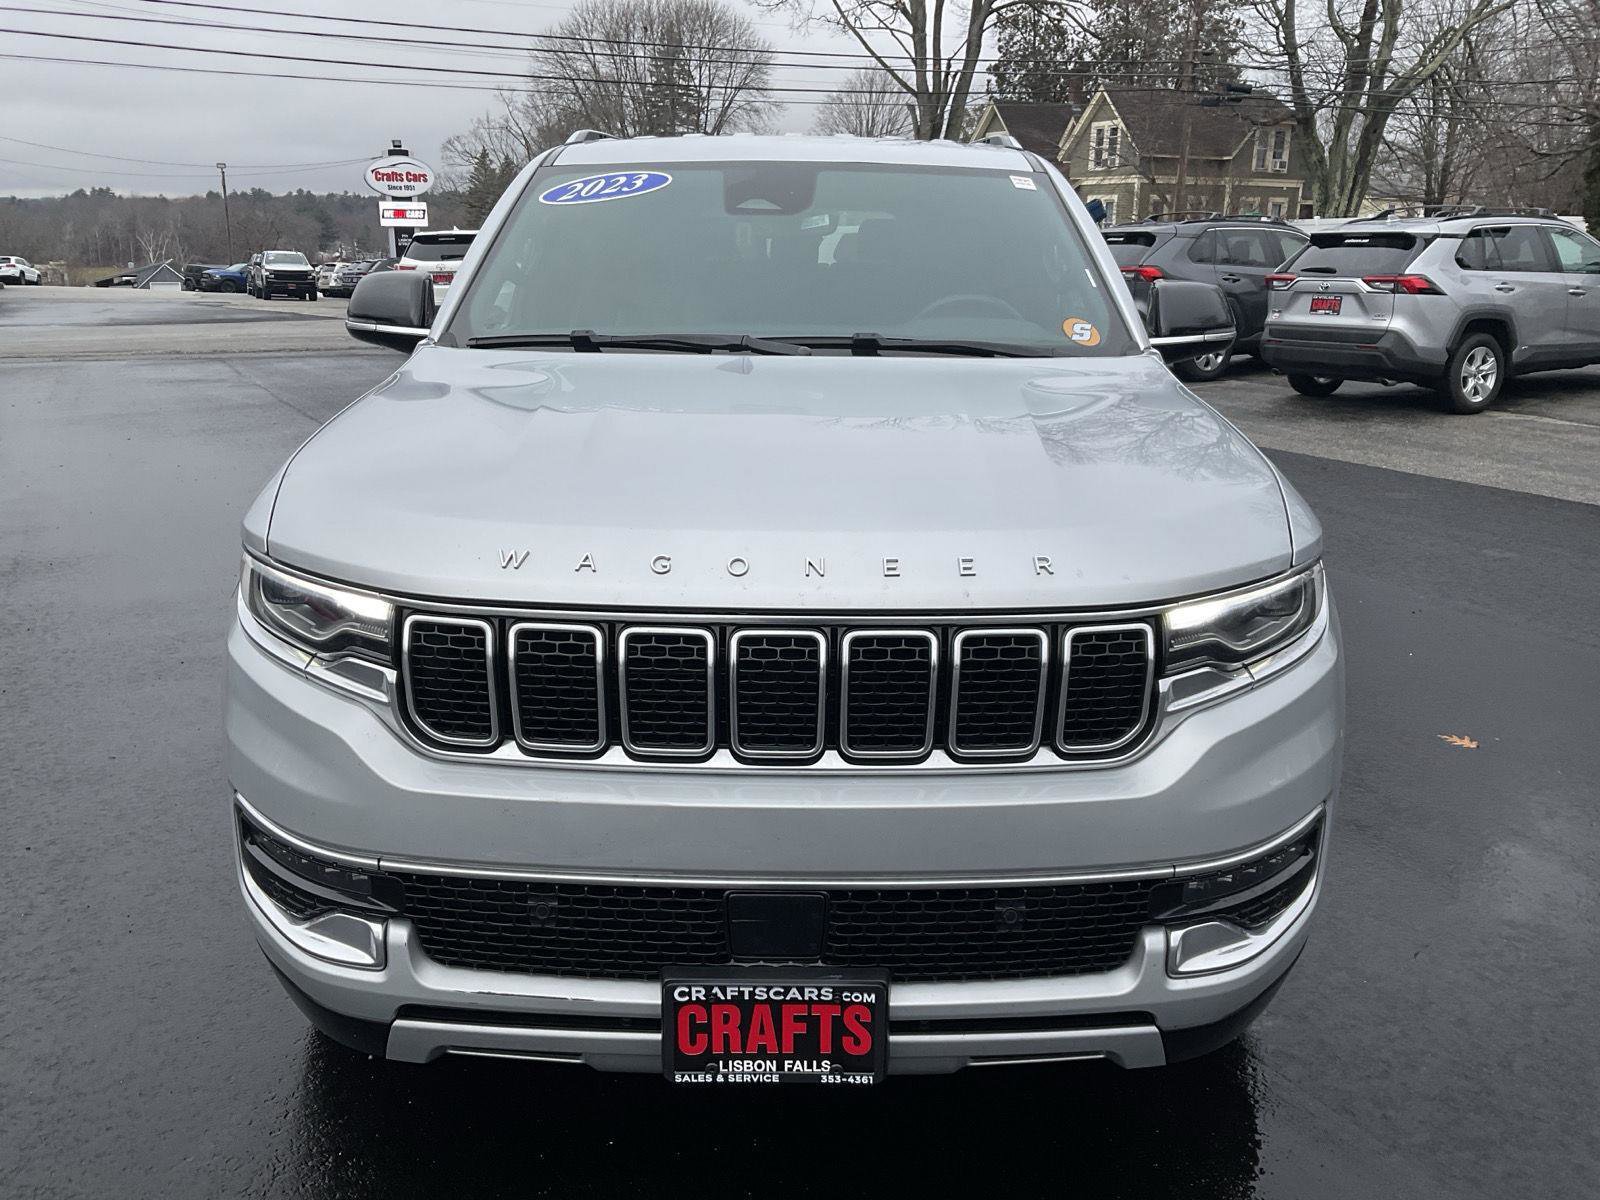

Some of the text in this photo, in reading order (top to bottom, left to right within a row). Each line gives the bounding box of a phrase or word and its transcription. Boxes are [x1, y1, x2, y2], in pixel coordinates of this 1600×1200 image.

[374, 170, 428, 183] Crafts Cars
[556, 173, 649, 201] 2023
[498, 548, 1054, 577] WAGONEER
[673, 986, 876, 1003] CRAFTSCARSCOM
[677, 1003, 873, 1056] CRAFTS
[719, 1060, 831, 1072] LISBON FALLS
[674, 1074, 780, 1082] SALES & SERVICE
[820, 1075, 874, 1084] 353-4361
